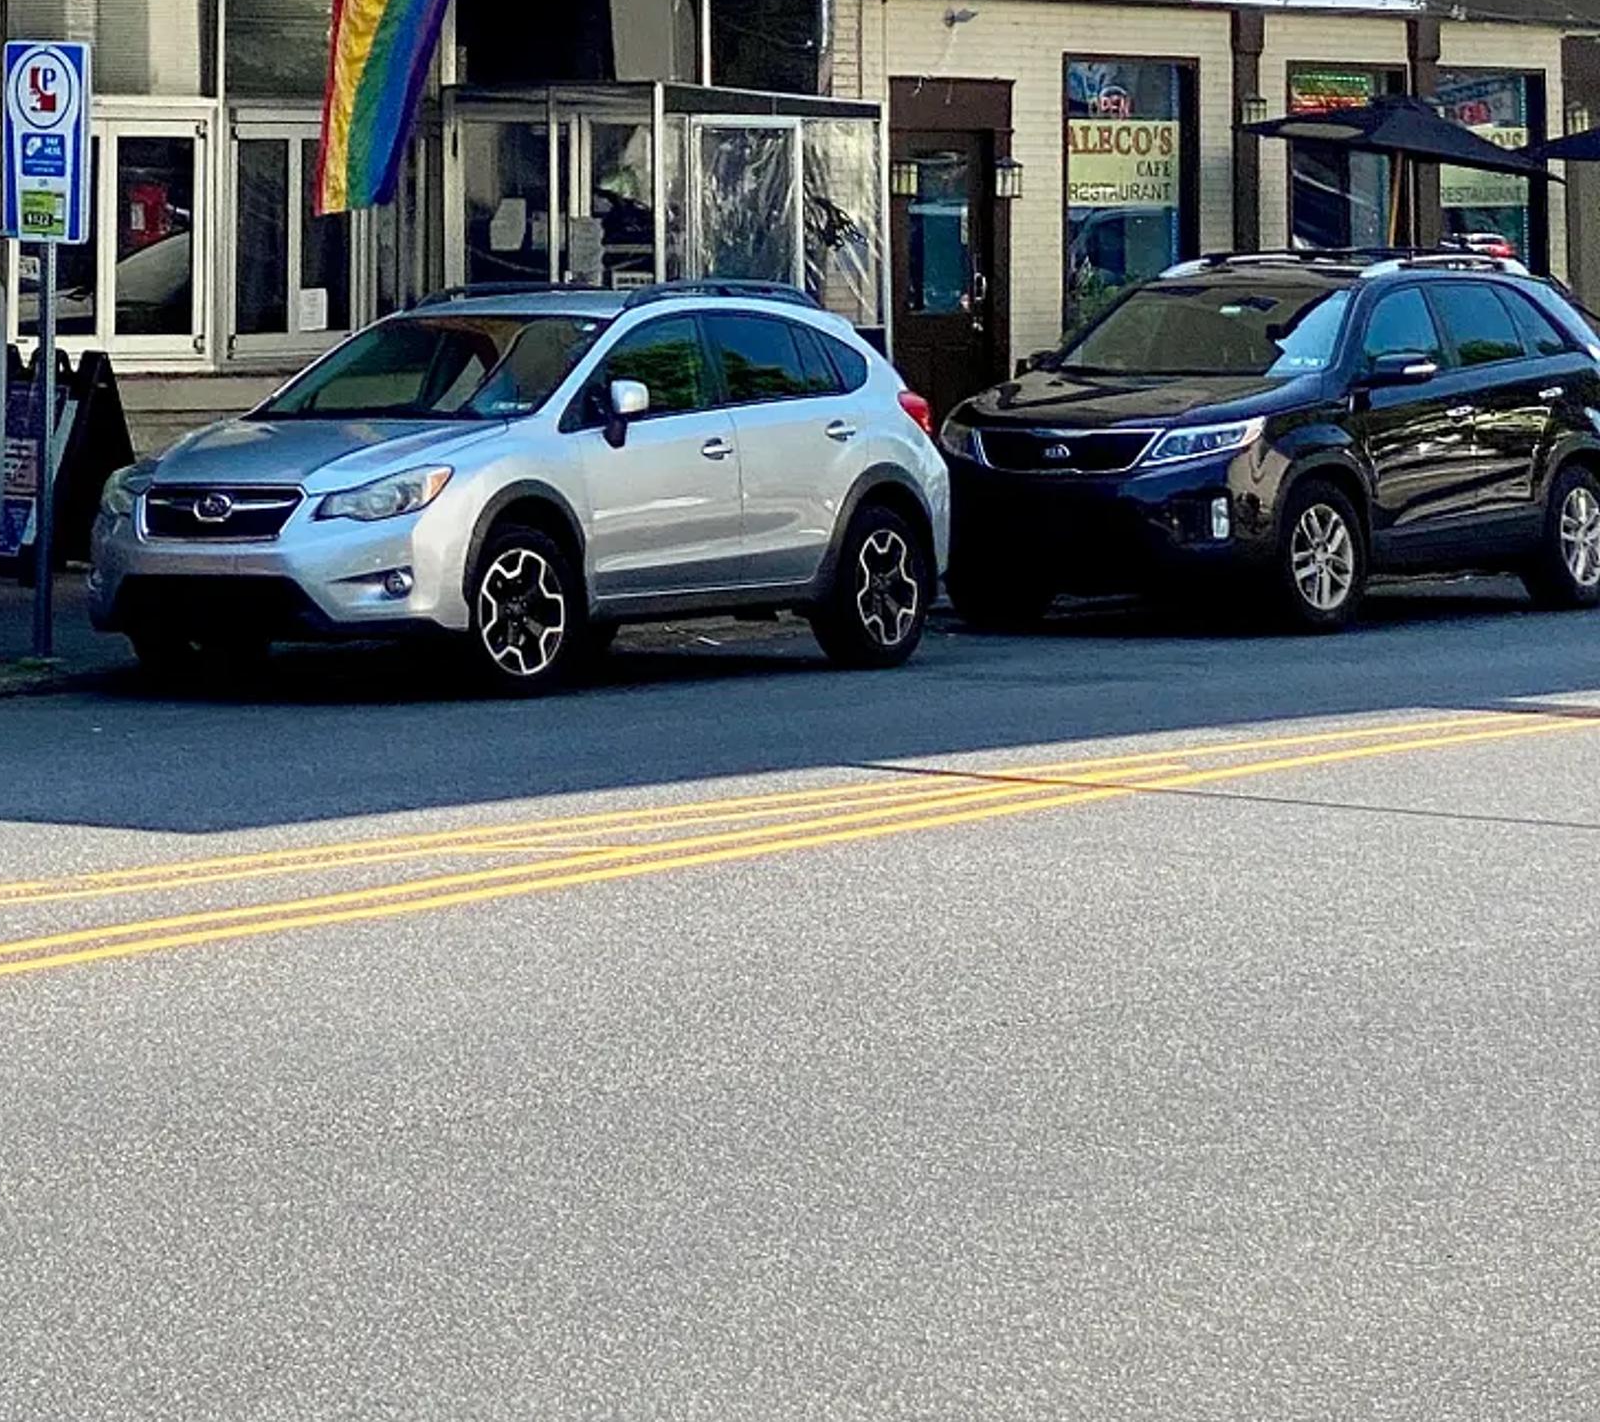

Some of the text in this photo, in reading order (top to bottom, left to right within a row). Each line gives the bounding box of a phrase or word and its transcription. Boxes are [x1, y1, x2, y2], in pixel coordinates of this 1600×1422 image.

[1068, 125, 1174, 155] ALECO'S
[1136, 160, 1173, 177] CAFE
[1068, 182, 1173, 202] RESTAURANT
